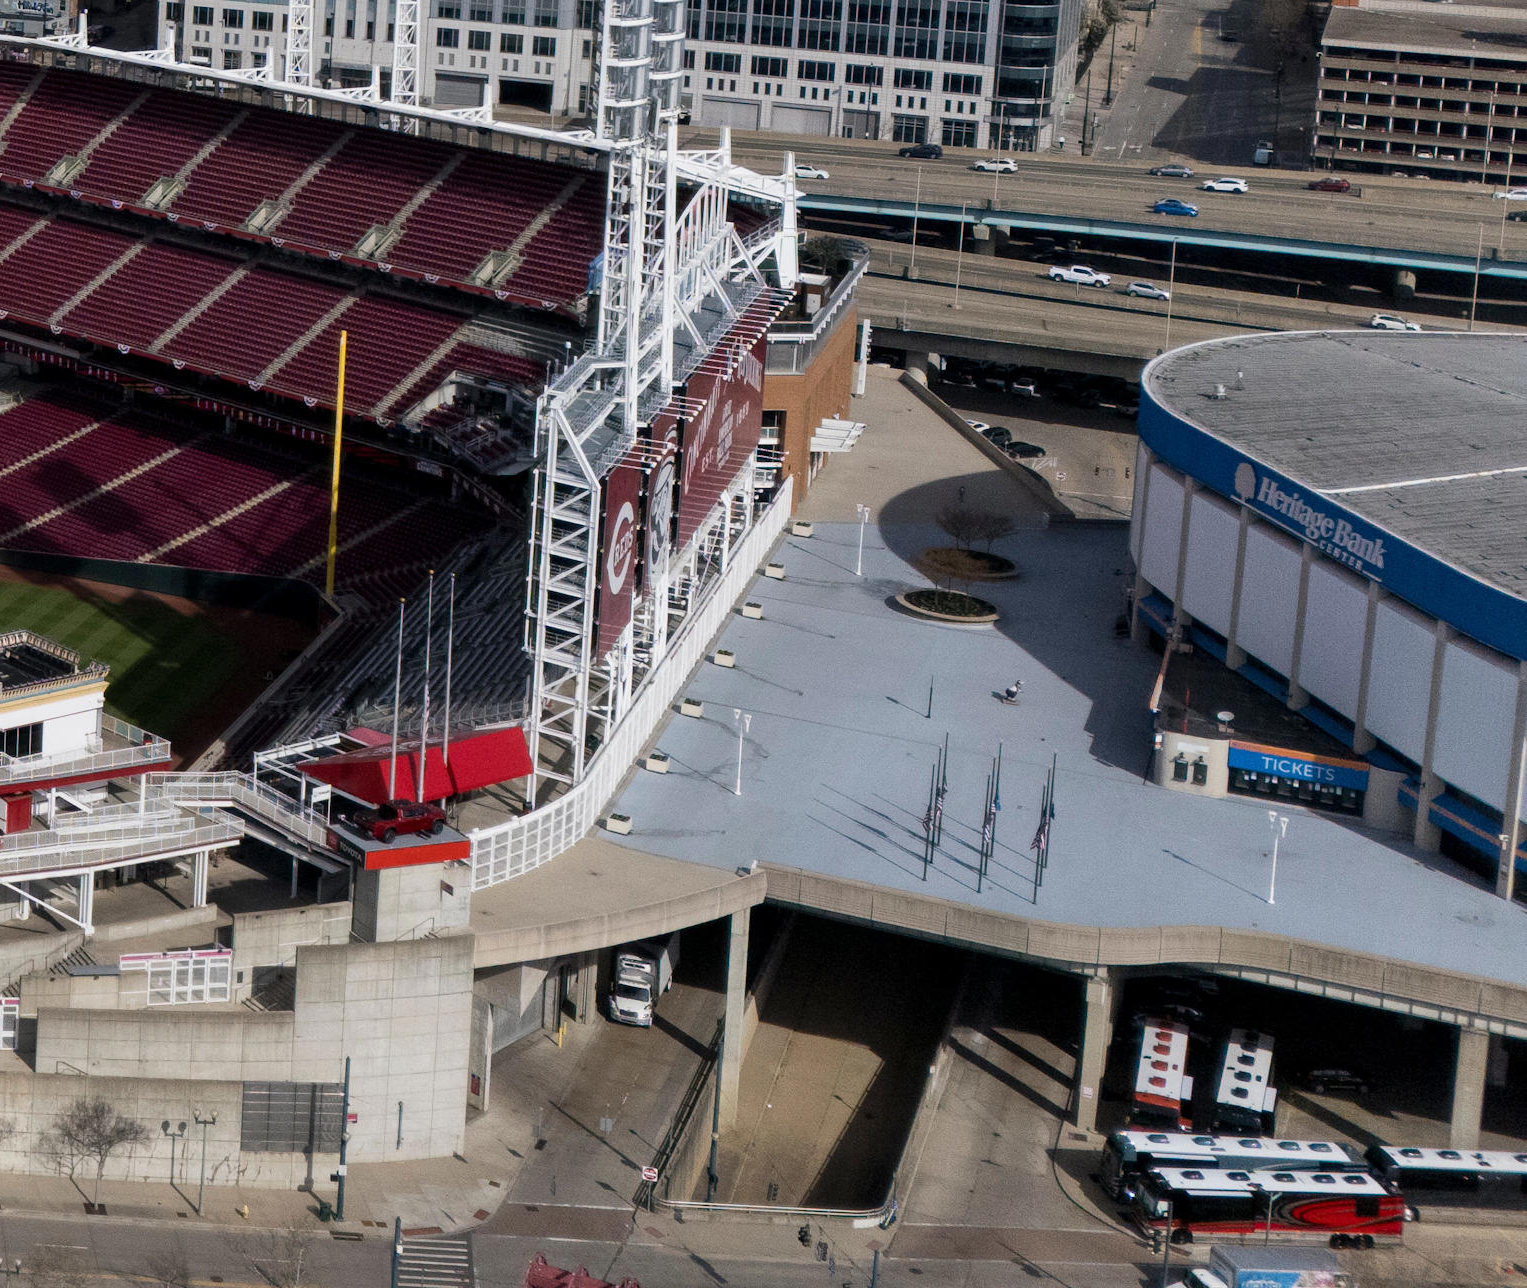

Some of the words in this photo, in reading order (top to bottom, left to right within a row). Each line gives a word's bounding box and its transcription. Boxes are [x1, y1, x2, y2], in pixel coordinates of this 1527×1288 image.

[1318, 540, 1365, 572] CENTER
[1261, 756, 1336, 783] TICKETS
[339, 839, 363, 862] TOYOTA
